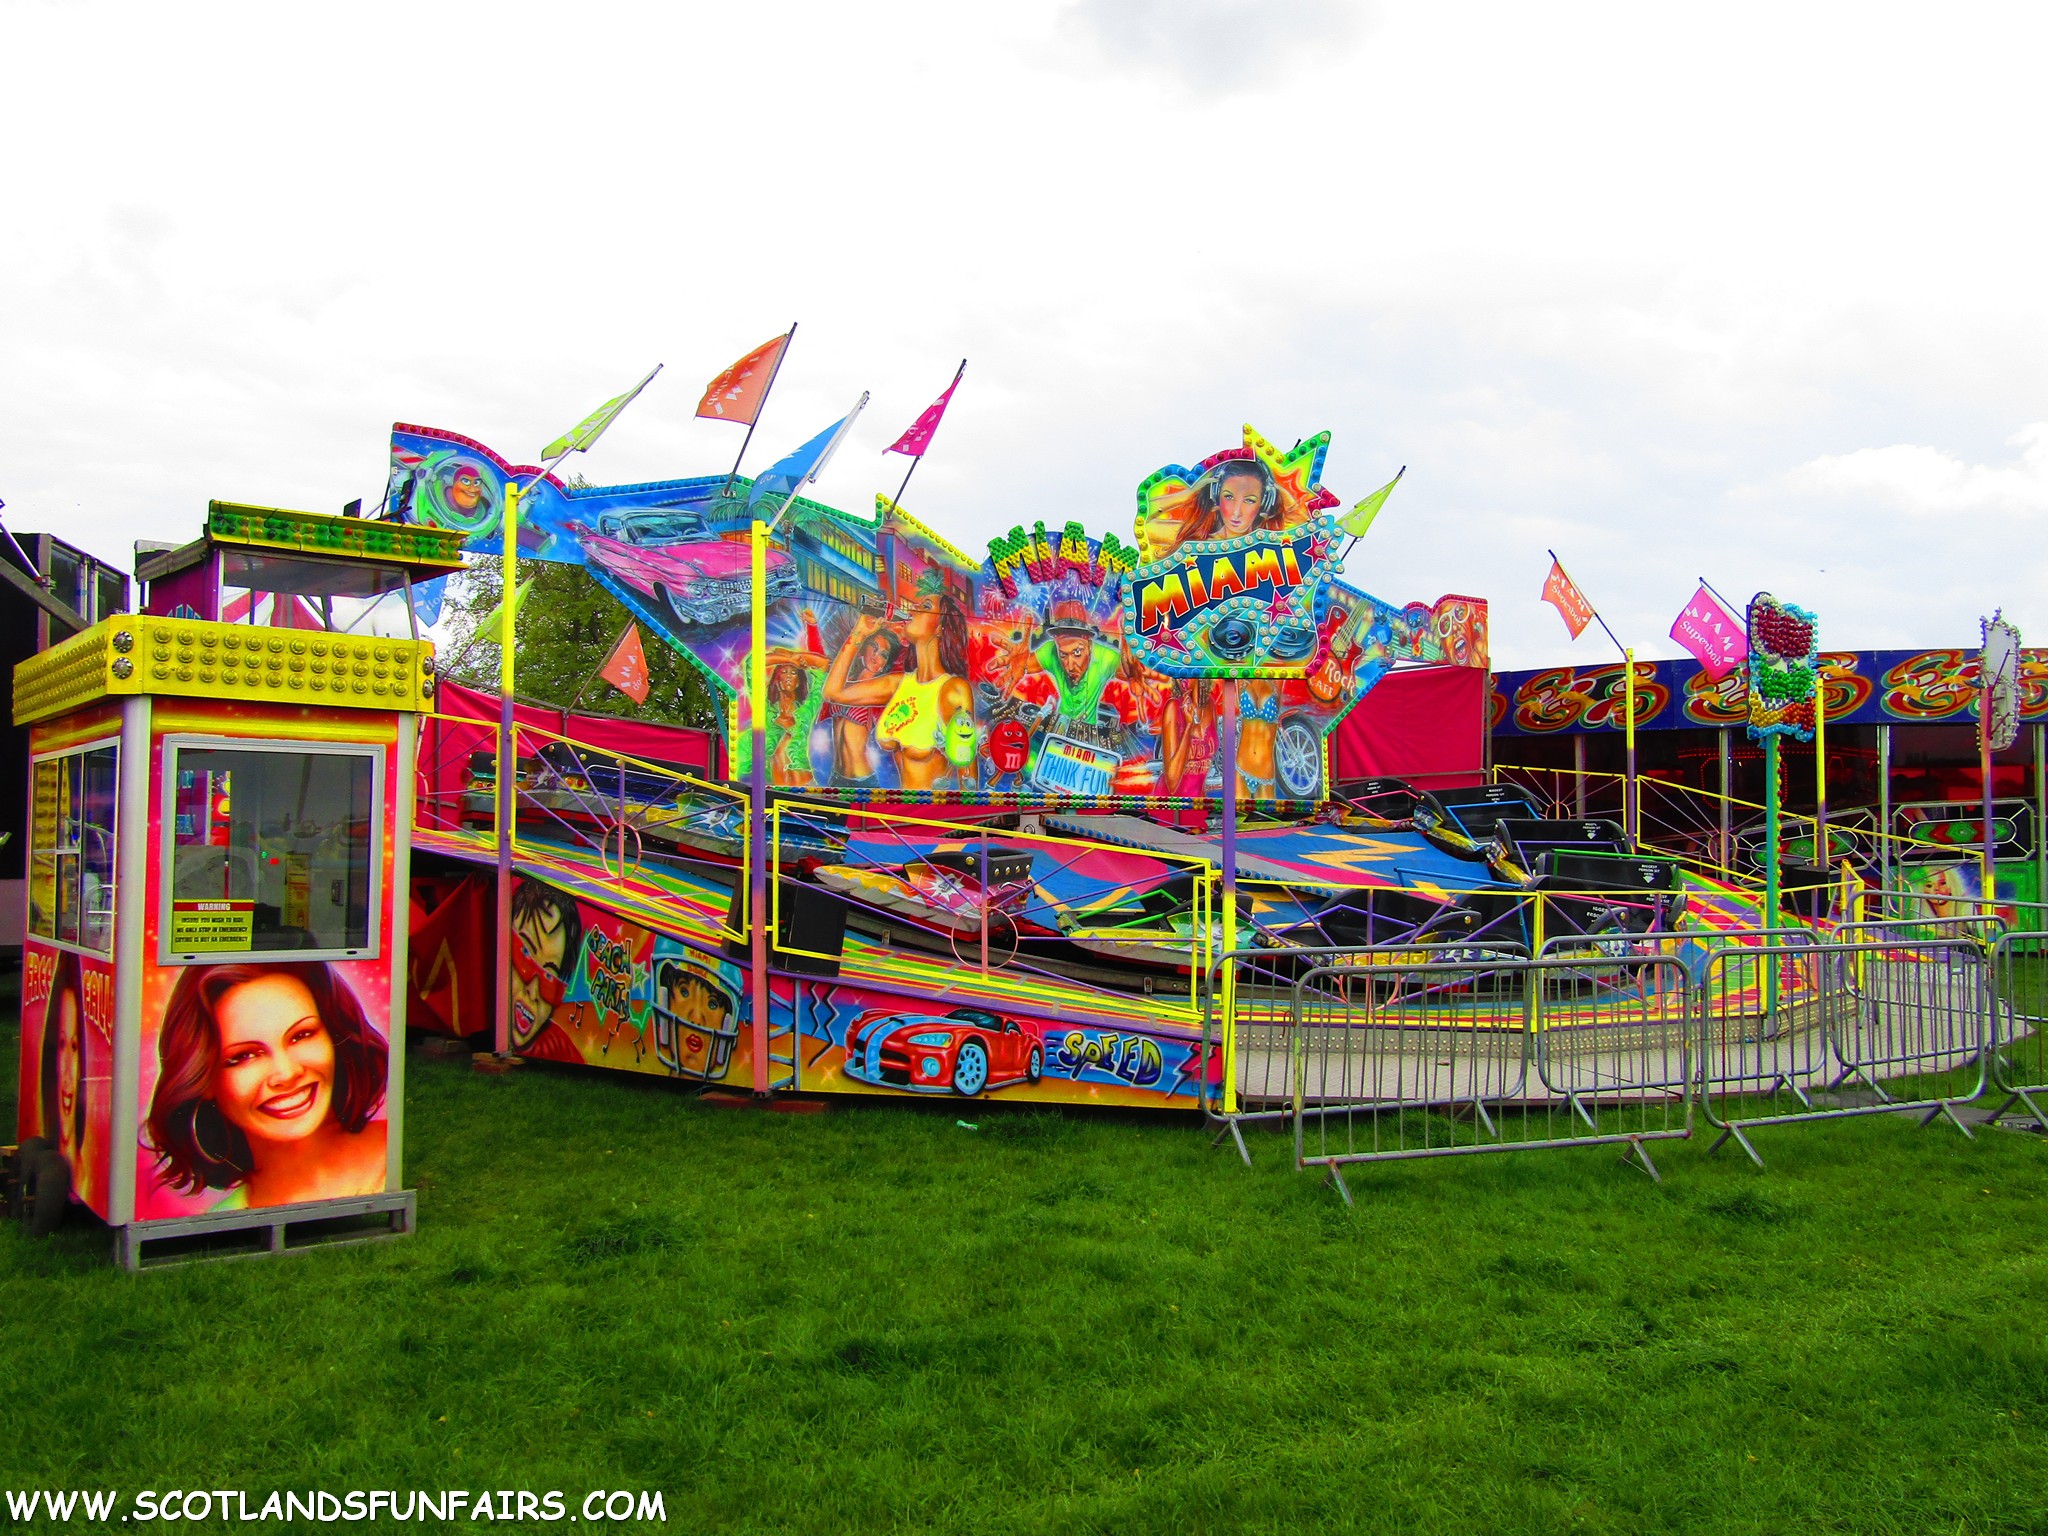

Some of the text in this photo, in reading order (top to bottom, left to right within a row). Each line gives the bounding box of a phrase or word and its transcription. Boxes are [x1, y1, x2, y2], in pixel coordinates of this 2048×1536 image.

[987, 520, 1139, 600] MIAM
[1141, 538, 1304, 633] MIAMI
[1680, 620, 1721, 667] Superbob
[1682, 607, 1735, 663] MIAMI
[1041, 753, 1112, 795] THINK FUN
[1063, 744, 1096, 763] MIAMI
[198, 903, 231, 911] WARNING
[586, 924, 633, 977] BEACH
[82, 969, 113, 1046] FALL
[590, 967, 631, 1034] PARTY
